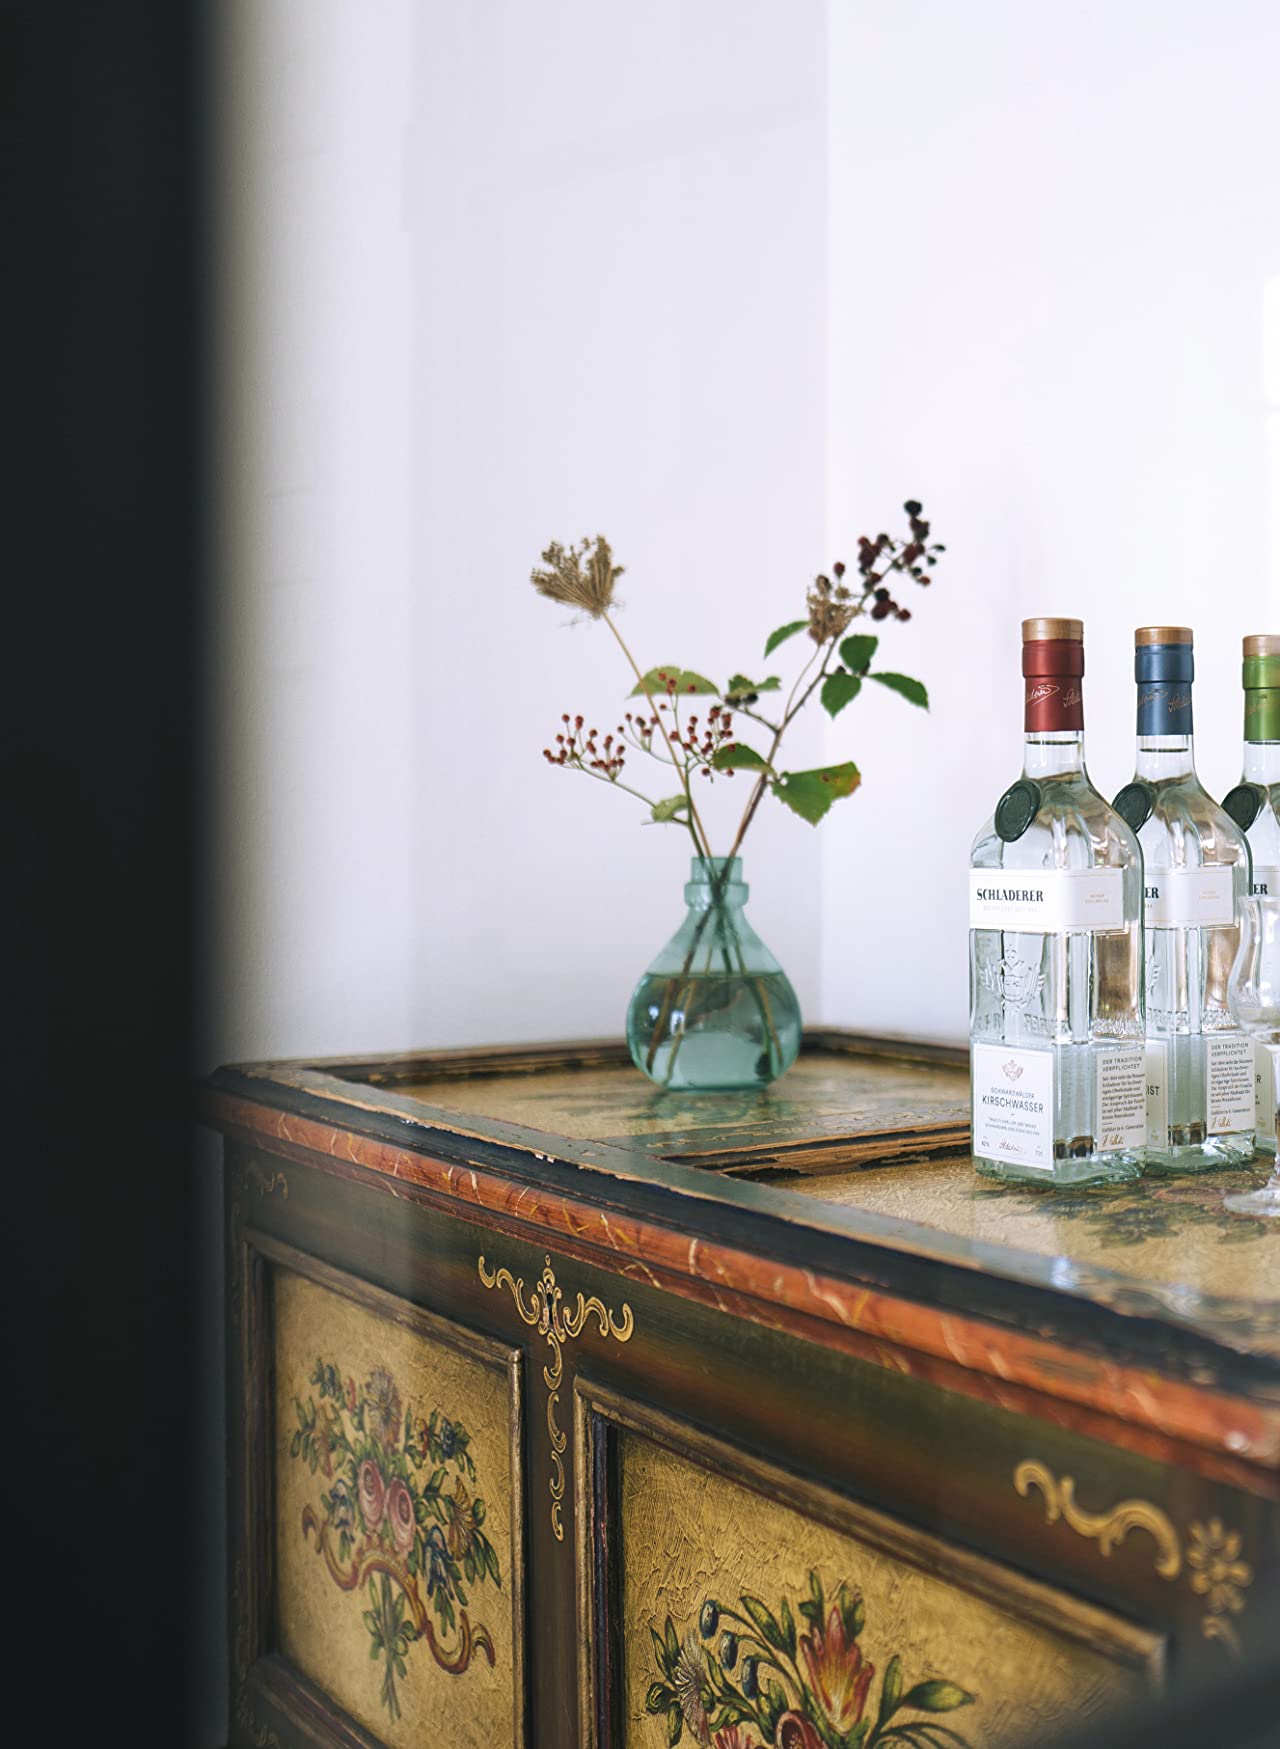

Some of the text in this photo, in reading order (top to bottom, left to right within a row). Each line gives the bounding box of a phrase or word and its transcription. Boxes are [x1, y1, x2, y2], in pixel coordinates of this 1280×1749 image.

[976, 888, 1044, 902] SCHLADERER
[1211, 1049, 1247, 1057] VERPFLICHTET
[1114, 1056, 1142, 1064] TRADITION
[1102, 1063, 1140, 1072] VERPFLICHTET
[982, 1095, 1044, 1113] KIRSCHWASSER
